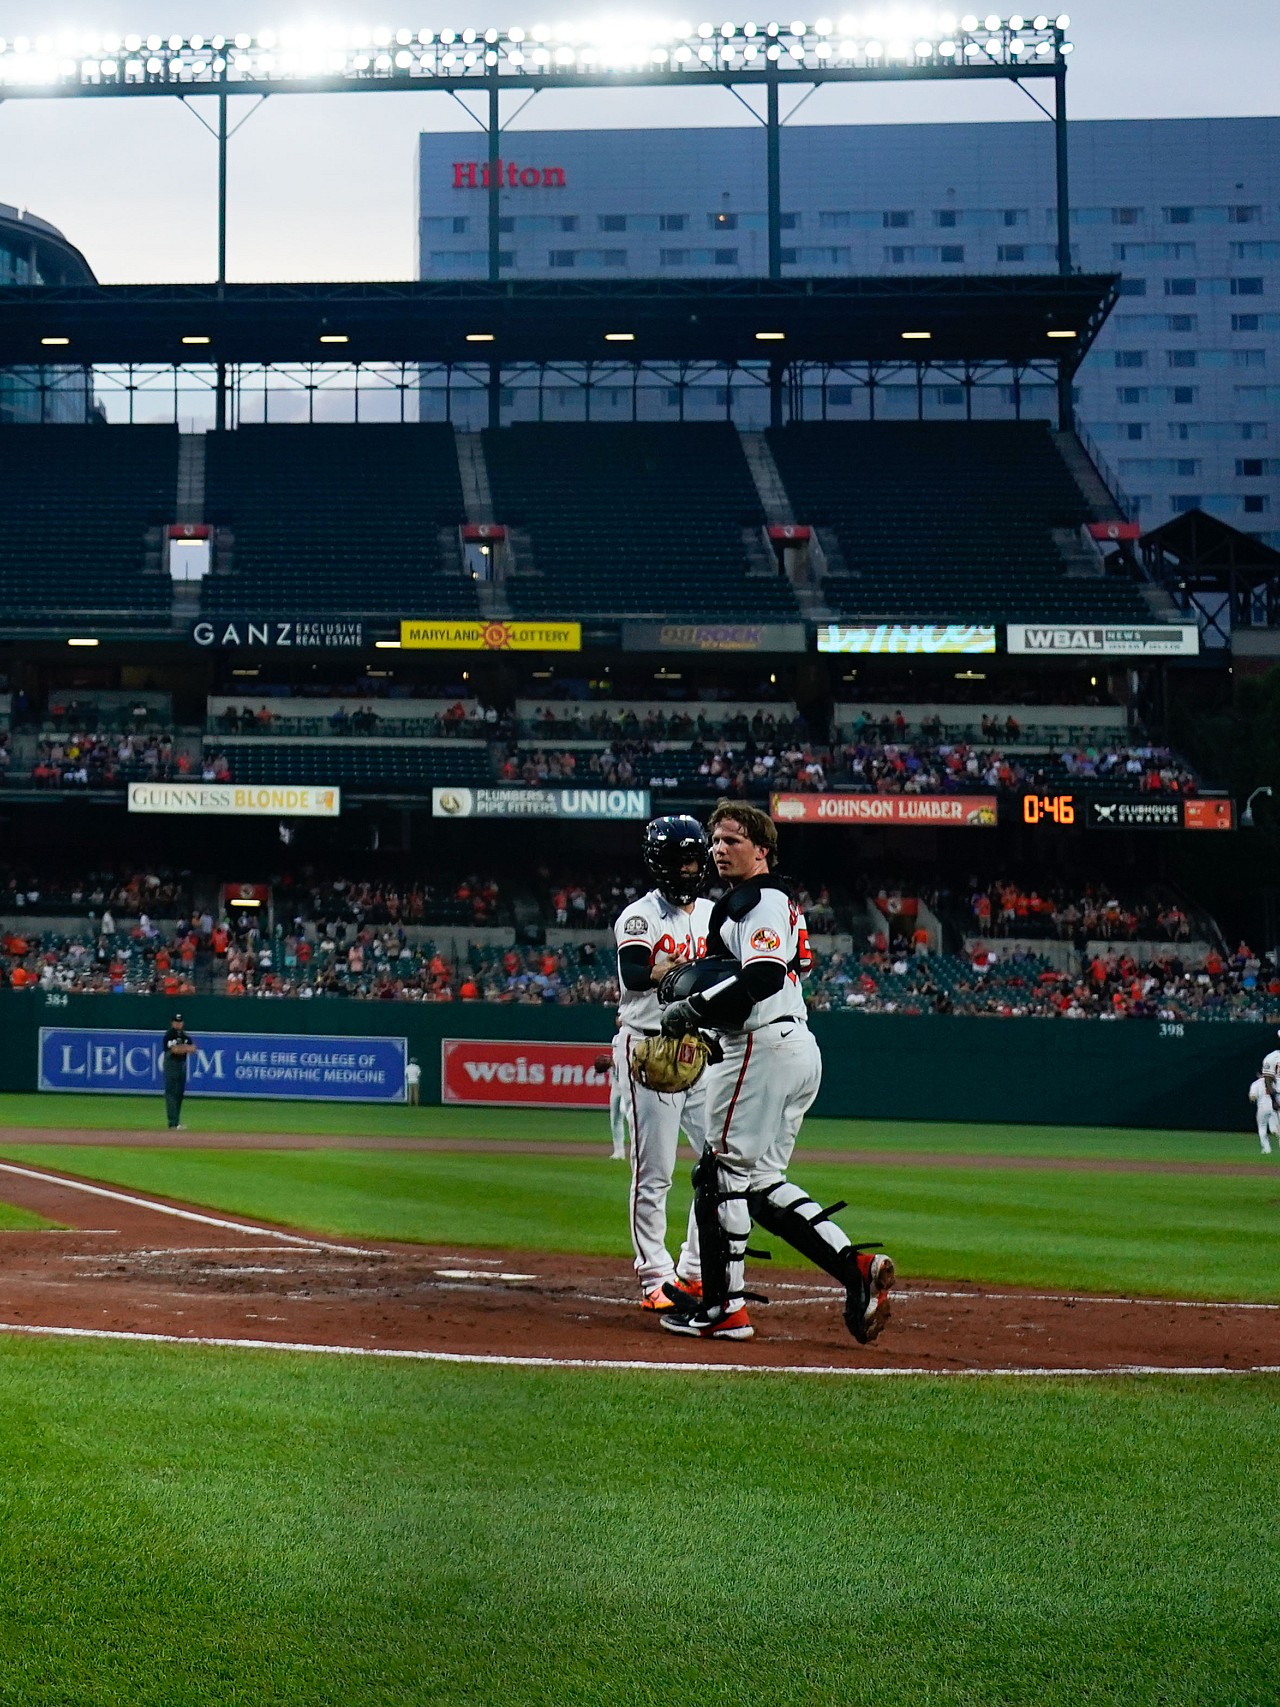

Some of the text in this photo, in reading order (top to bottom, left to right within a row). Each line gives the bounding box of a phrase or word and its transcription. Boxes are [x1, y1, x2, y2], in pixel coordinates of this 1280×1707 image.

[451, 158, 566, 188] Hilton
[193, 622, 292, 646] GANZ
[295, 622, 362, 635] EXCLUSIVE
[409, 628, 479, 641] MARYLAND
[512, 630, 569, 643] LOTTERY
[1107, 631, 1141, 641] NEWS
[295, 635, 362, 646] REAL ESTATE
[1025, 630, 1103, 649] WBAL
[132, 787, 309, 809] GUINNESS BLONDE
[477, 789, 544, 801] PLUMBERS
[561, 789, 645, 814] UNION
[477, 801, 558, 814] PIPE FITTERS
[818, 799, 963, 819] JOHNSON LUMBER
[1023, 794, 1075, 824] 0:46
[1119, 804, 1178, 815] CLUBHOUSE
[45, 993, 69, 1008] 384
[1159, 1023, 1185, 1038] 398
[61, 1043, 225, 1079] LECM
[235, 1051, 376, 1067] LAKE ERIE COLLEGE OF
[235, 1066, 386, 1084] OSTEOPATHIC MEDICINE
[464, 1056, 546, 1085] weis
